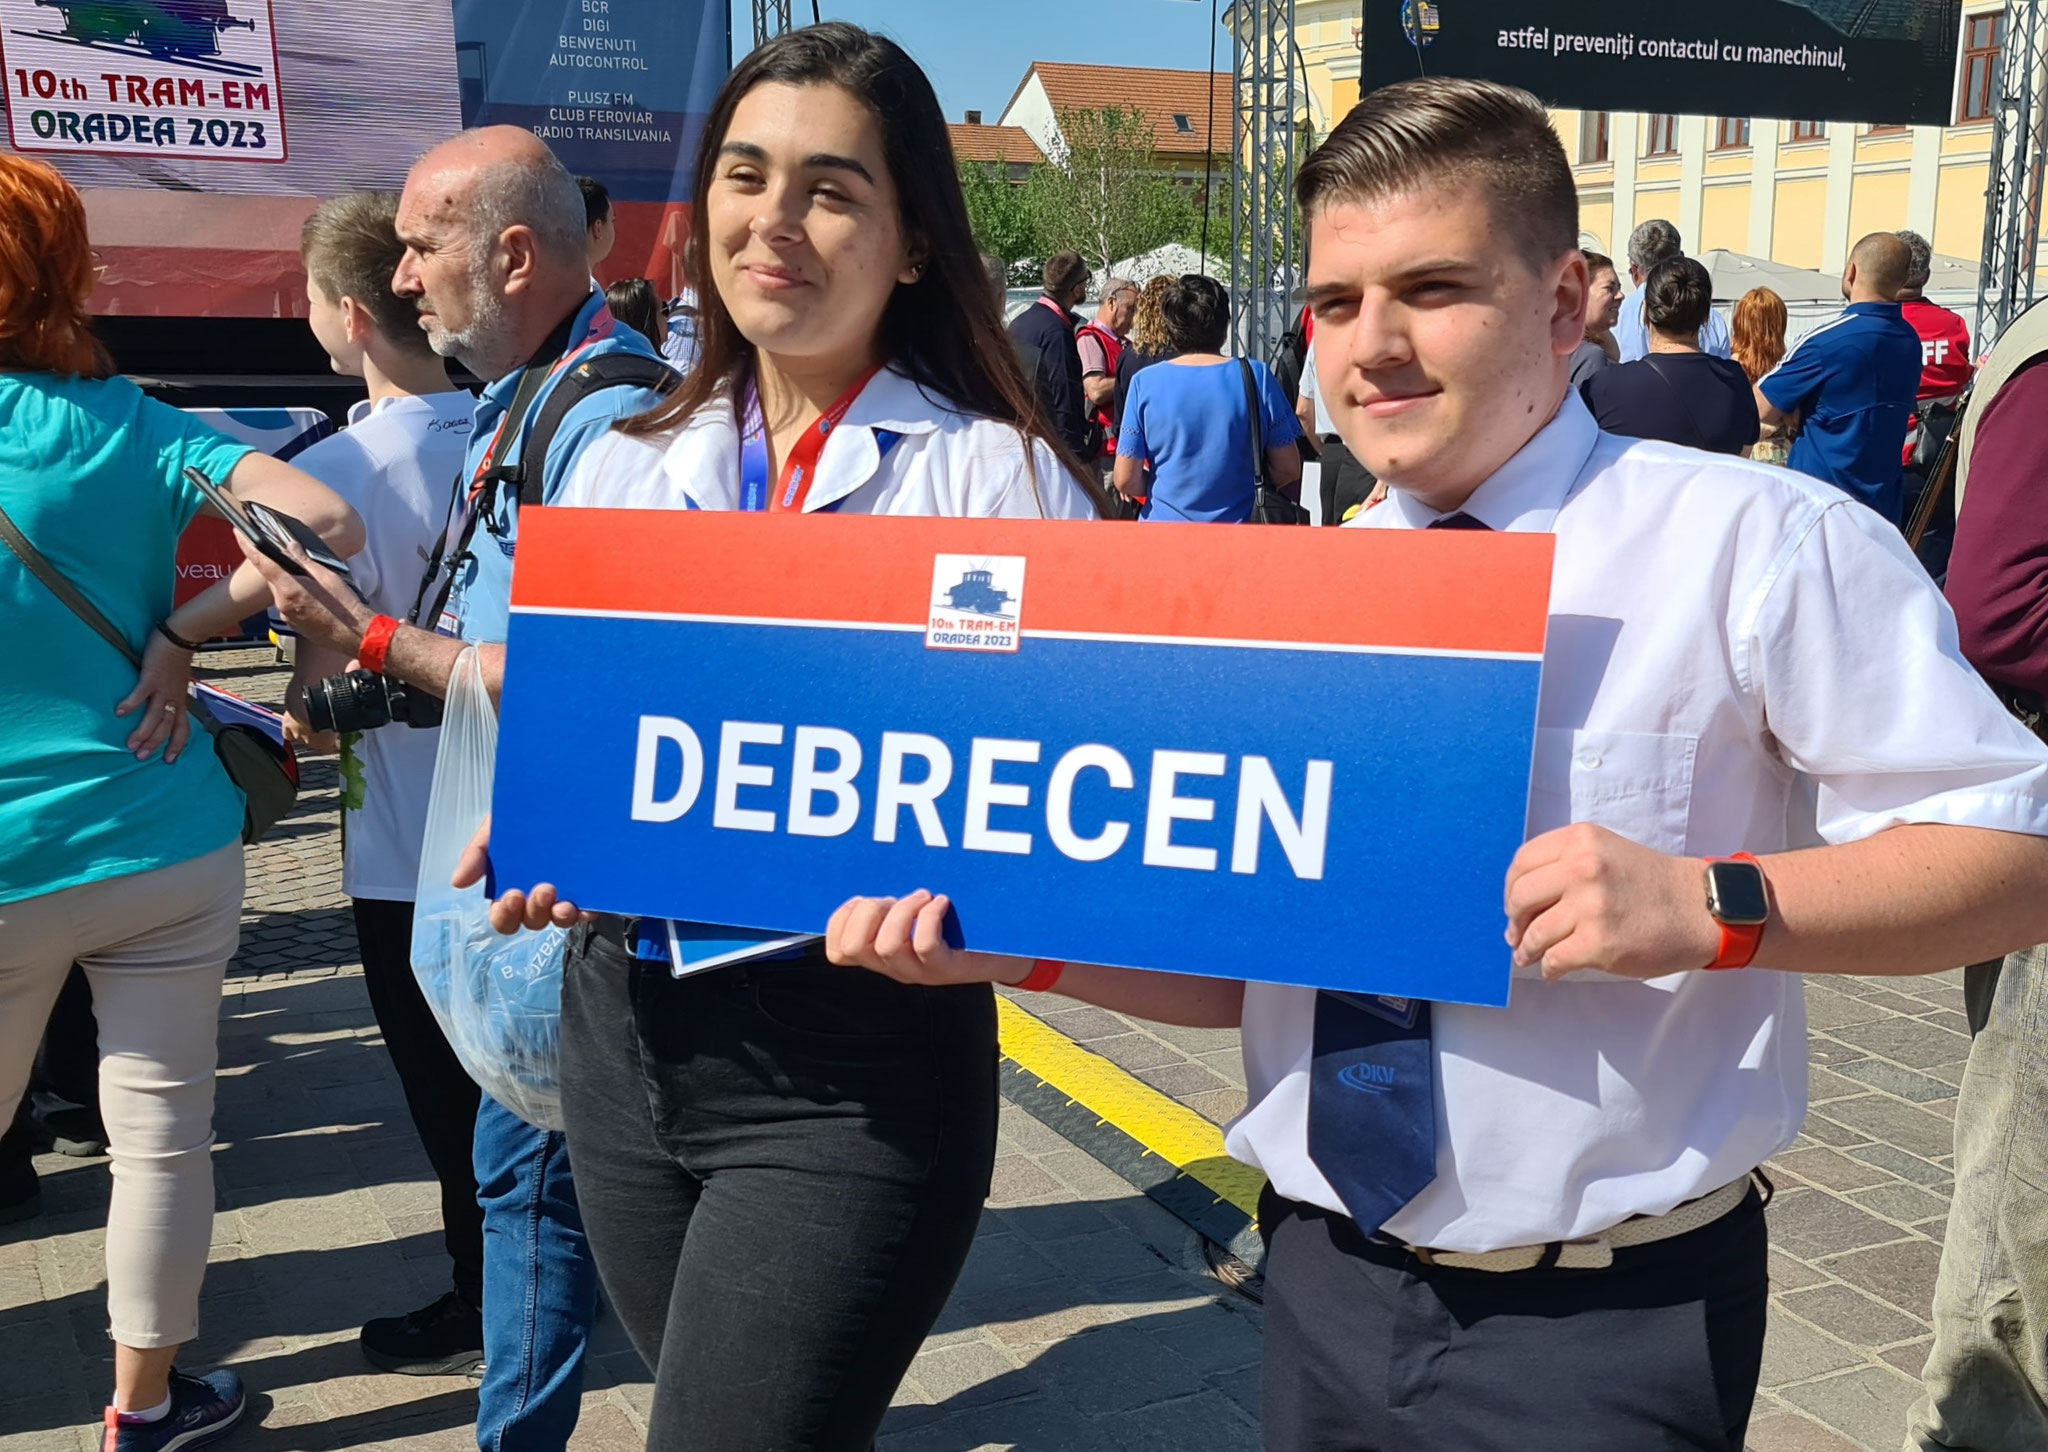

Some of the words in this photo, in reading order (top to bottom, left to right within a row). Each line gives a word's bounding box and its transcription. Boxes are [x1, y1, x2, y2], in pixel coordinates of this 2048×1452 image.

[582, 0, 609, 13] BCR
[583, 18, 610, 32] DIGI
[559, 35, 636, 52] BENVENUTI
[1497, 26, 1549, 50] astfel
[1553, 33, 1634, 61] preveniți
[1638, 38, 1718, 61] contactul
[1722, 45, 1742, 62] cu
[1746, 44, 1847, 71] manechinul,
[549, 53, 648, 70] AUTOCONTROL
[14, 68, 88, 100] 10th
[100, 73, 271, 111] TRAM-EM
[568, 90, 611, 106] PLUSZ
[614, 92, 634, 106] FM
[549, 107, 586, 122] CLUB
[589, 109, 653, 125] FEROVIAR
[30, 109, 177, 147] ORADEA
[186, 118, 267, 149] 2023
[533, 125, 574, 140] RADIO
[577, 127, 671, 143] TRANSILVANIA
[931, 617, 955, 631] 10th
[959, 618, 1016, 633] TRAM-EM
[933, 632, 981, 646] ORADEA
[984, 634, 1012, 647] 2023
[630, 714, 1334, 881] DEBRECEN
